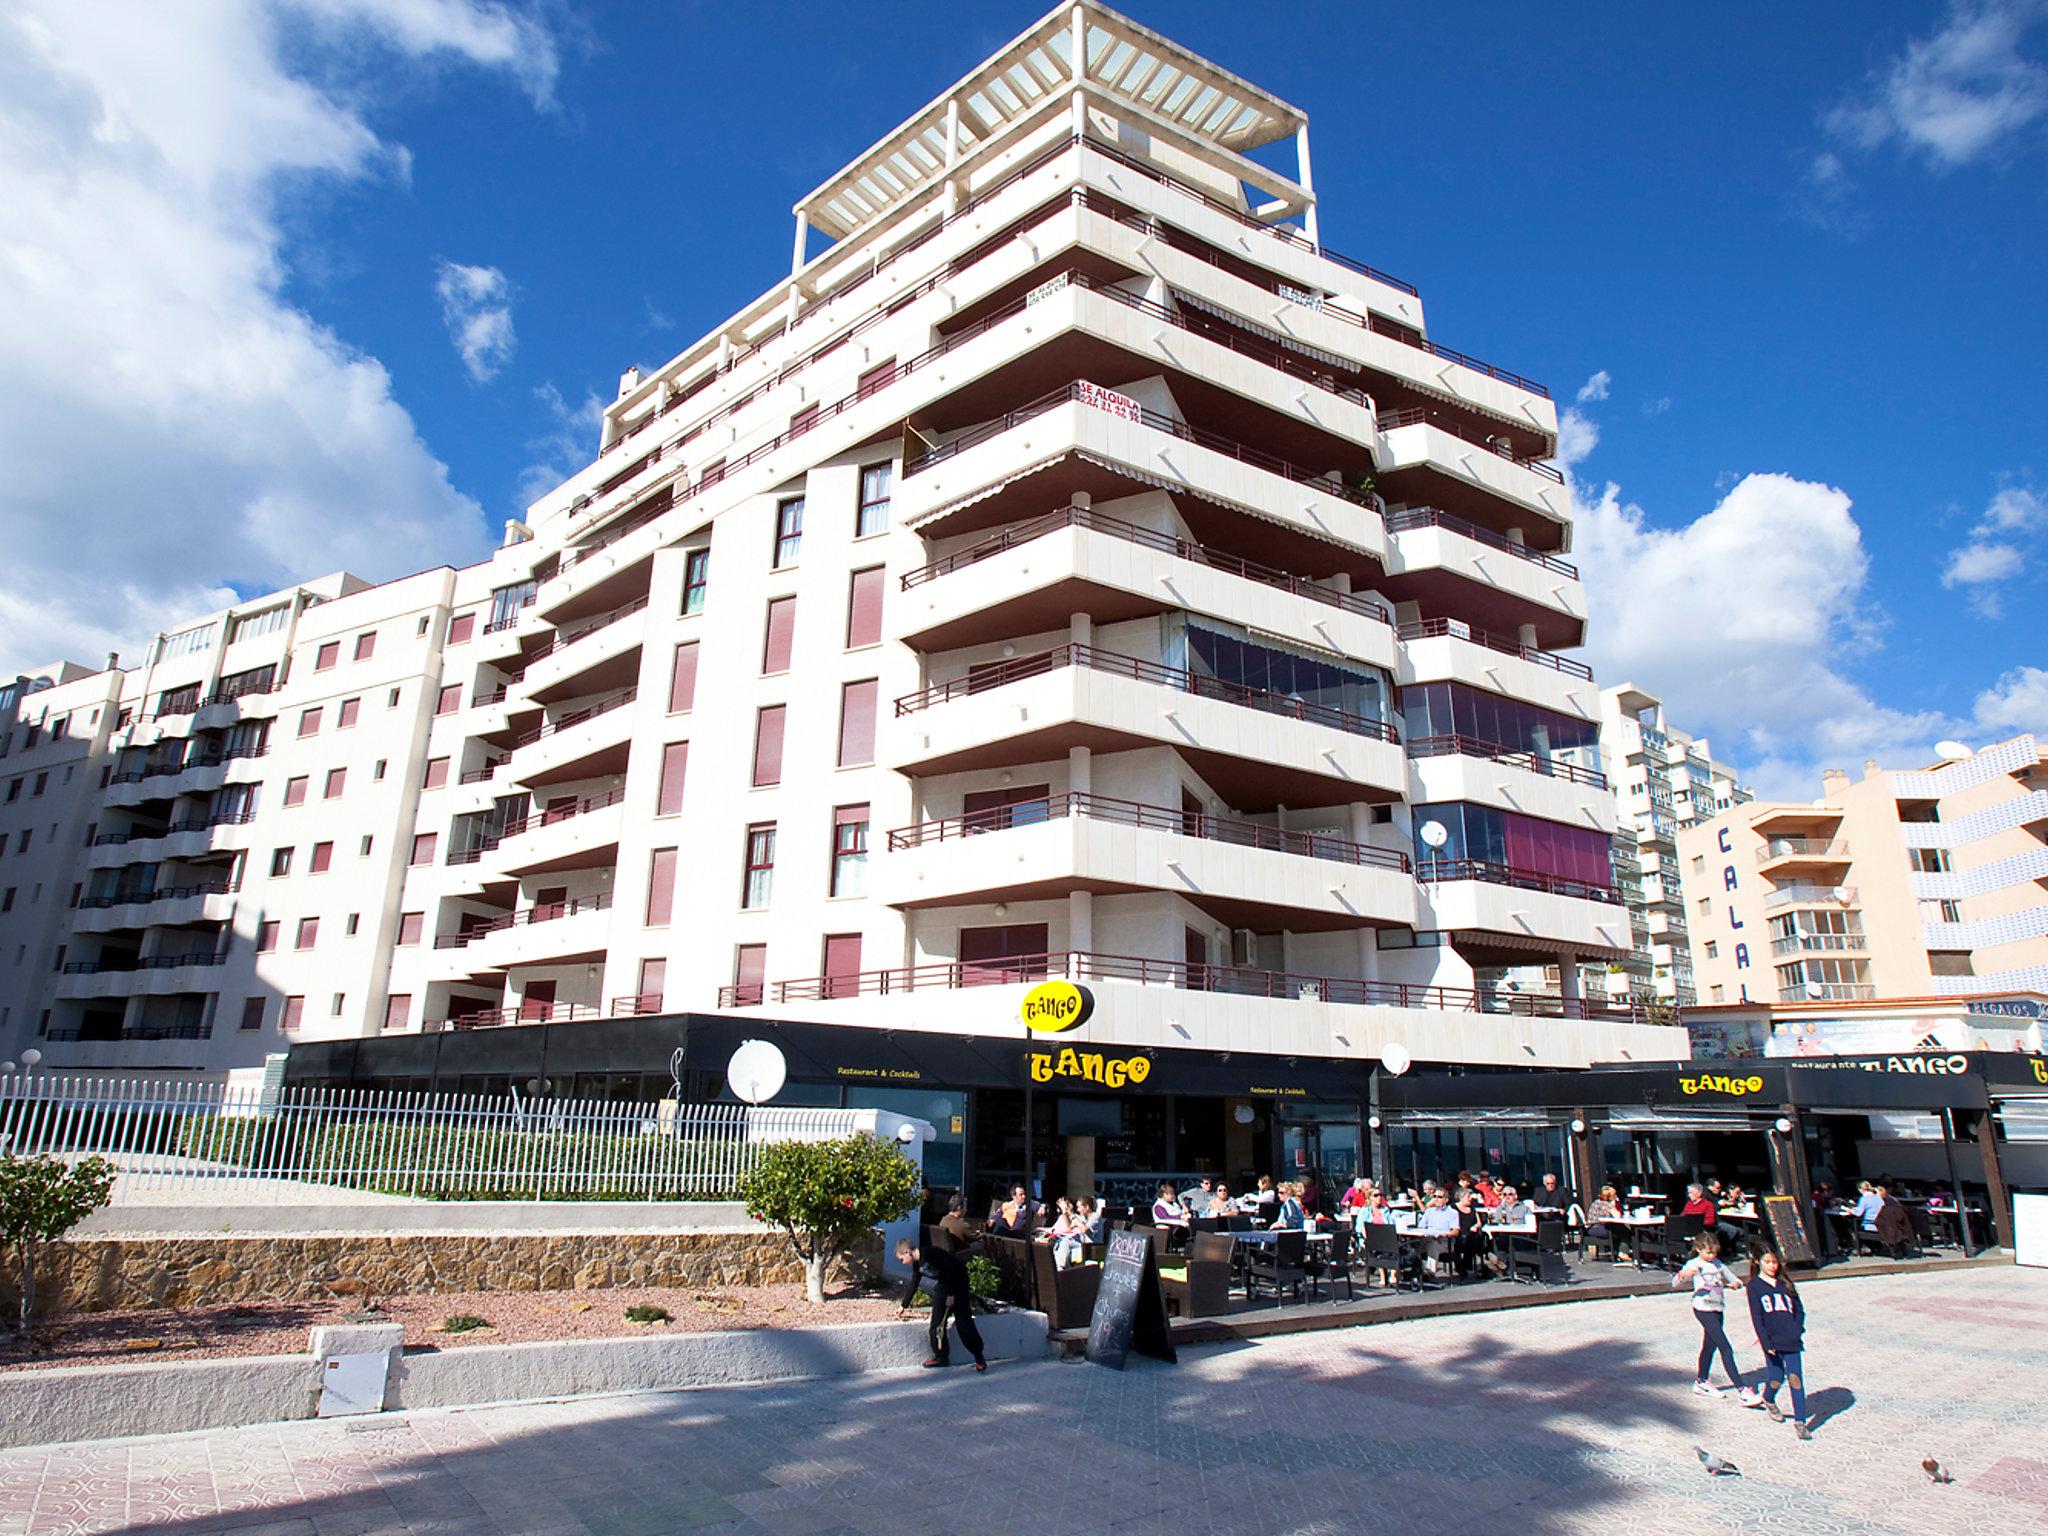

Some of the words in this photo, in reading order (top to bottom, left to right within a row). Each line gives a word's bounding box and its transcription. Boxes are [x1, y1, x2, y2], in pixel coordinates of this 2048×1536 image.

[1081, 382, 1093, 394] SE
[1095, 388, 1139, 413] ALQUILA
[1025, 995, 1077, 1020] TANGO
[889, 1069, 921, 1079] Cocktails
[1025, 1047, 1151, 1089] TANGO
[1679, 1074, 1764, 1096] TANGO
